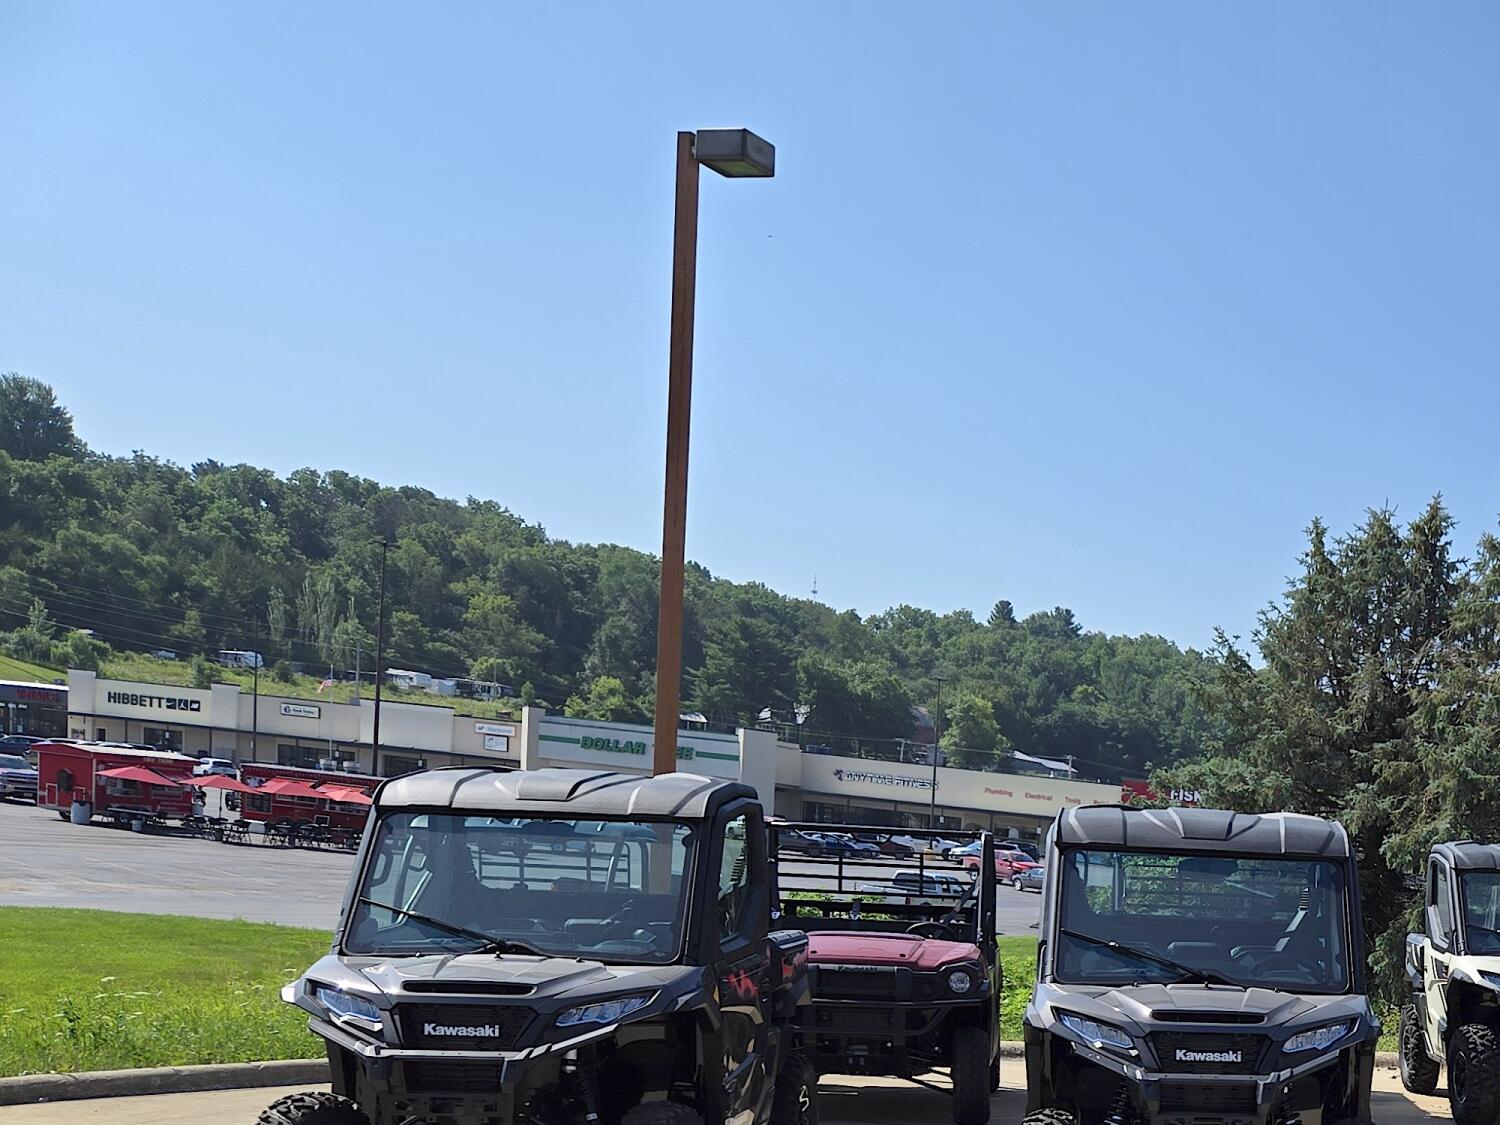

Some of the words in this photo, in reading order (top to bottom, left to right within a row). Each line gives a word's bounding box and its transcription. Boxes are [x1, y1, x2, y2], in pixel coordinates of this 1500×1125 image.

[107, 691, 165, 708] HIBBETT
[580, 736, 646, 755] DOLLAR
[845, 771, 892, 785] ANYTIME
[984, 787, 1013, 797] Plumbing
[1024, 792, 1053, 801] Electrical
[423, 1022, 500, 1038] Kawasaki
[1175, 1049, 1242, 1063] Kawasaki
